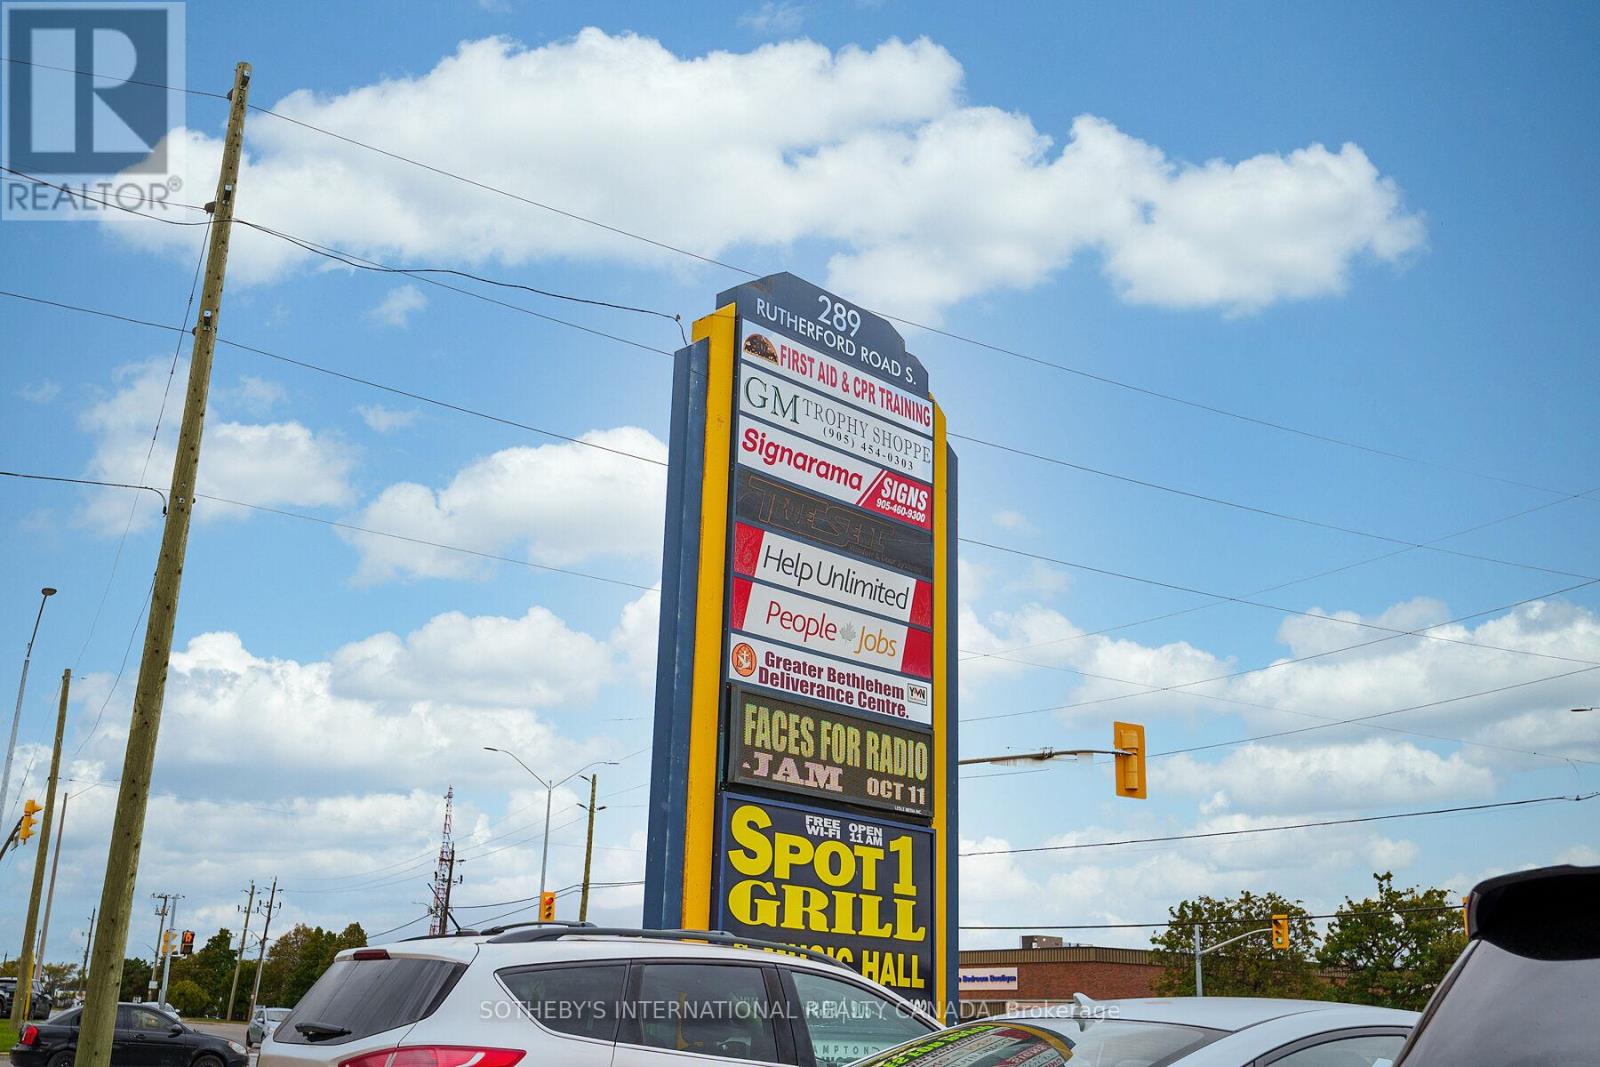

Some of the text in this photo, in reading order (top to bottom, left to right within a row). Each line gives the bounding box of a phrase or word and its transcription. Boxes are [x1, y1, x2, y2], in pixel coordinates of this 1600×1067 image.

[818, 295, 861, 337] 289
[756, 298, 856, 357] RUTHERFORD
[861, 347, 900, 377] ROAD
[905, 367, 917, 386] S.
[780, 345, 815, 379] FIRST
[818, 362, 838, 388] AID
[842, 371, 850, 394] &
[853, 376, 876, 405] CPR
[879, 386, 931, 427] TRAINING
[744, 376, 931, 464] GM TROPHY SHOPPE
[742, 428, 928, 511] Signarama SIGNS
[823, 427, 914, 471] (905) 454-0303
[876, 499, 926, 523] 905-460-9300
[763, 544, 813, 587] Help
[816, 561, 909, 610] Unlimited
[766, 600, 838, 643] People
[758, 666, 909, 719] Deliverance Centre.
[765, 651, 905, 701] Greater Bethlehem
[744, 703, 928, 781] FACES FOR RADIO
[866, 777, 904, 801] OCT
[908, 785, 925, 806] 11
[805, 815, 883, 837] FREE OPEN
[805, 825, 883, 846] WI-FI 11 AM
[728, 879, 926, 942] GRILL
[862, 950, 925, 989] HALL
